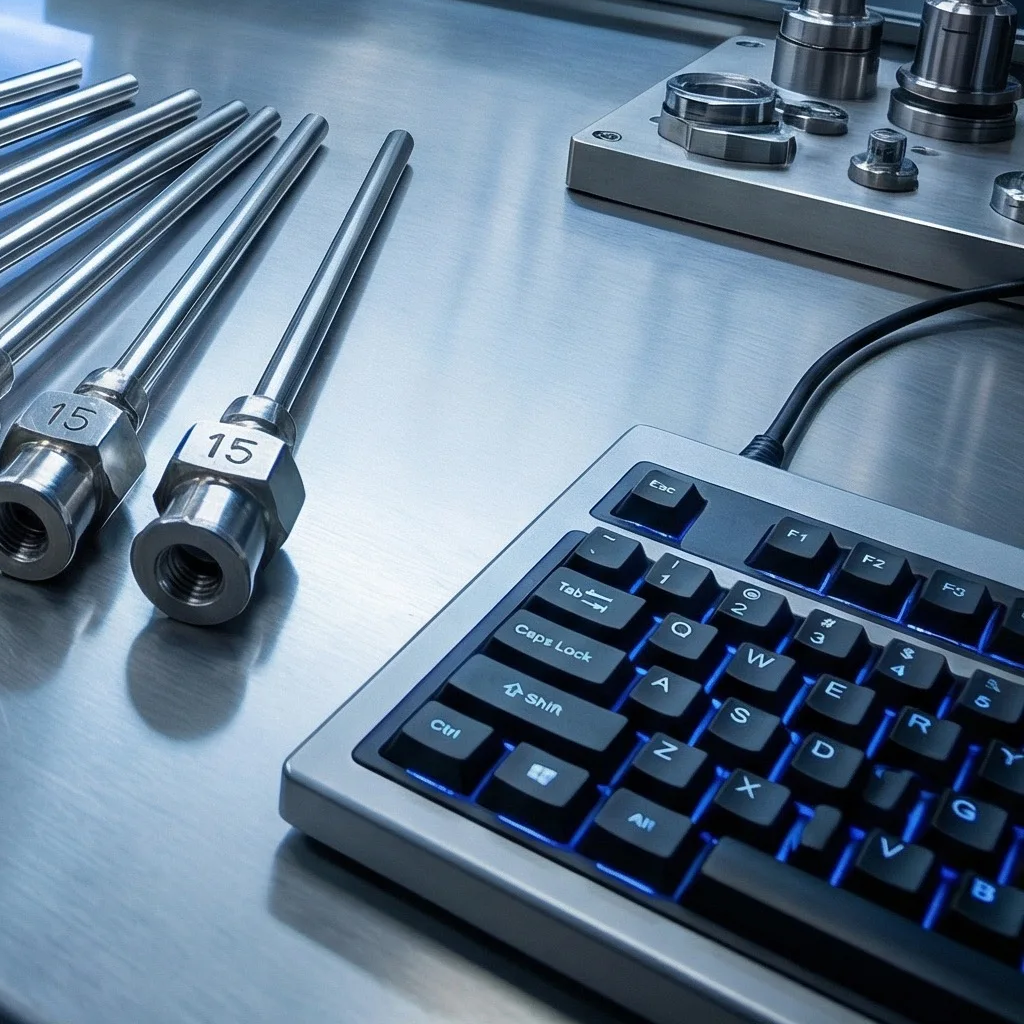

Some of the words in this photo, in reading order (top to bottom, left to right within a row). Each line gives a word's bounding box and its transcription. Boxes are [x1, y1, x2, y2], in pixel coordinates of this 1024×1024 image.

[47, 402, 98, 432] 15
[207, 432, 260, 466] 15
[786, 529, 809, 543] F1
[862, 554, 886, 570] F2
[558, 581, 583, 598] Tab
[941, 582, 966, 597] F3
[730, 602, 748, 616] 2
[809, 632, 825, 645] 3
[554, 640, 593, 663] Lock
[747, 648, 776, 668] W
[650, 676, 670, 693] A
[824, 680, 848, 699] E
[729, 707, 751, 724] S
[907, 713, 932, 735] R
[430, 718, 462, 740] Ctrl
[652, 739, 679, 761] Z
[811, 739, 836, 759] D
[1000, 747, 1024, 766] Y
[734, 775, 762, 800] X
[951, 799, 977, 822] G
[880, 836, 905, 859] V
[971, 877, 997, 903] B
